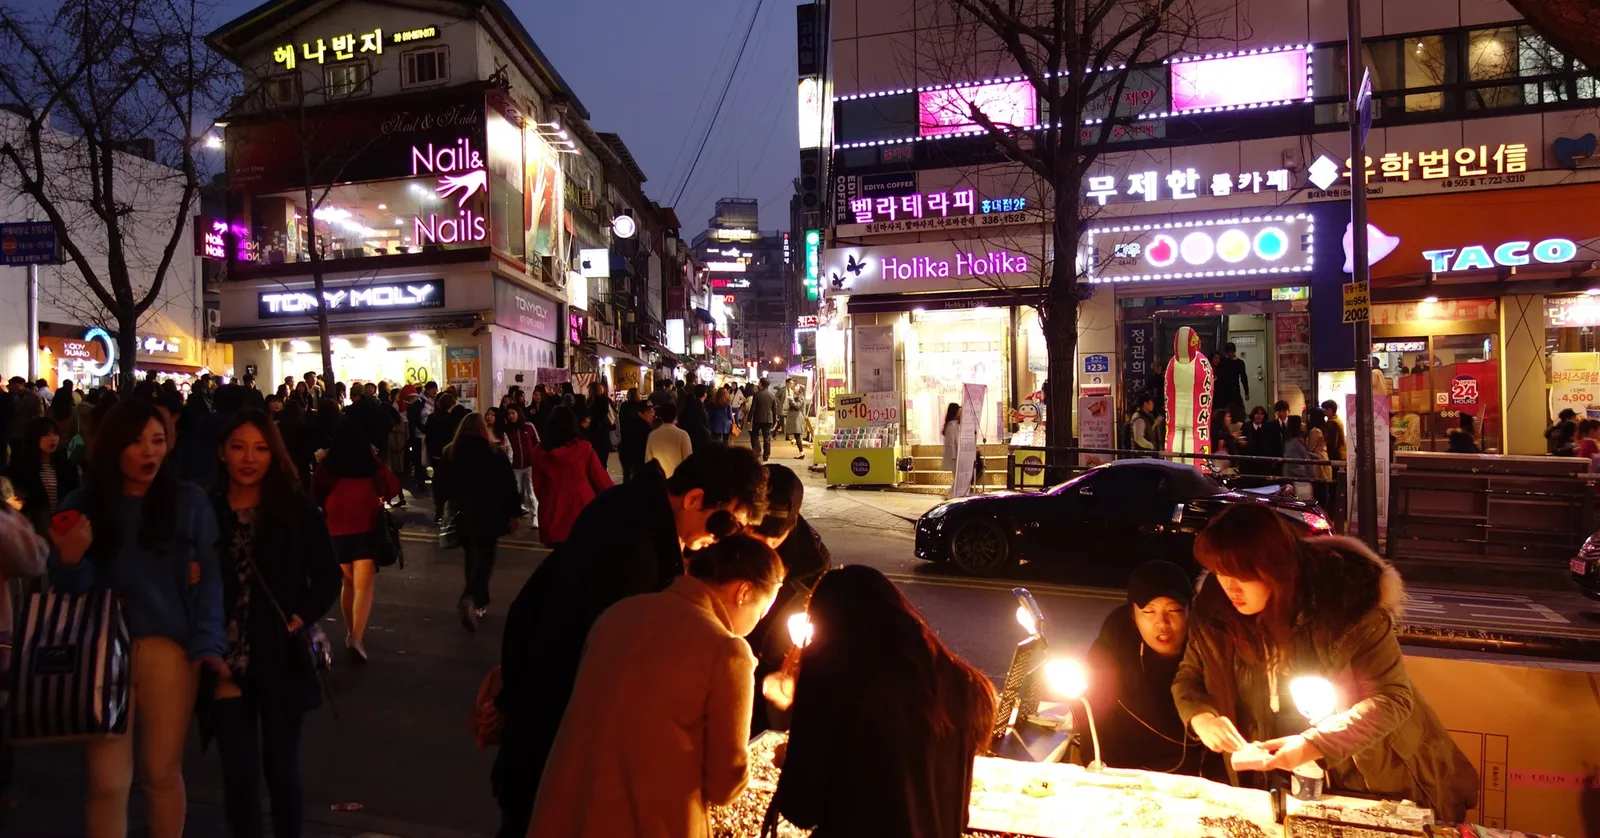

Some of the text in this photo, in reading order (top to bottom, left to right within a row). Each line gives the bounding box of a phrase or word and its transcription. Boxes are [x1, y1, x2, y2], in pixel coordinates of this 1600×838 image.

[381, 103, 477, 135] Nail & Nails
[864, 180, 914, 191] EDIYA COFFEE
[1488, 175, 1525, 185] 722-3210
[837, 175, 846, 221] COFFEE
[851, 190, 974, 223] 벨라테라피
[981, 213, 1026, 225] 336-1526
[414, 210, 486, 245] Nails
[1422, 238, 1577, 274] TACO
[880, 250, 1029, 280] Holika Holika
[515, 296, 548, 319] TONYMOLY
[1344, 307, 1369, 321] 2002
[64, 349, 90, 357] GUARD
[1552, 371, 1599, 383] 런치스페셜
[1453, 384, 1477, 399] 24
[1561, 393, 1594, 403] 4,900
